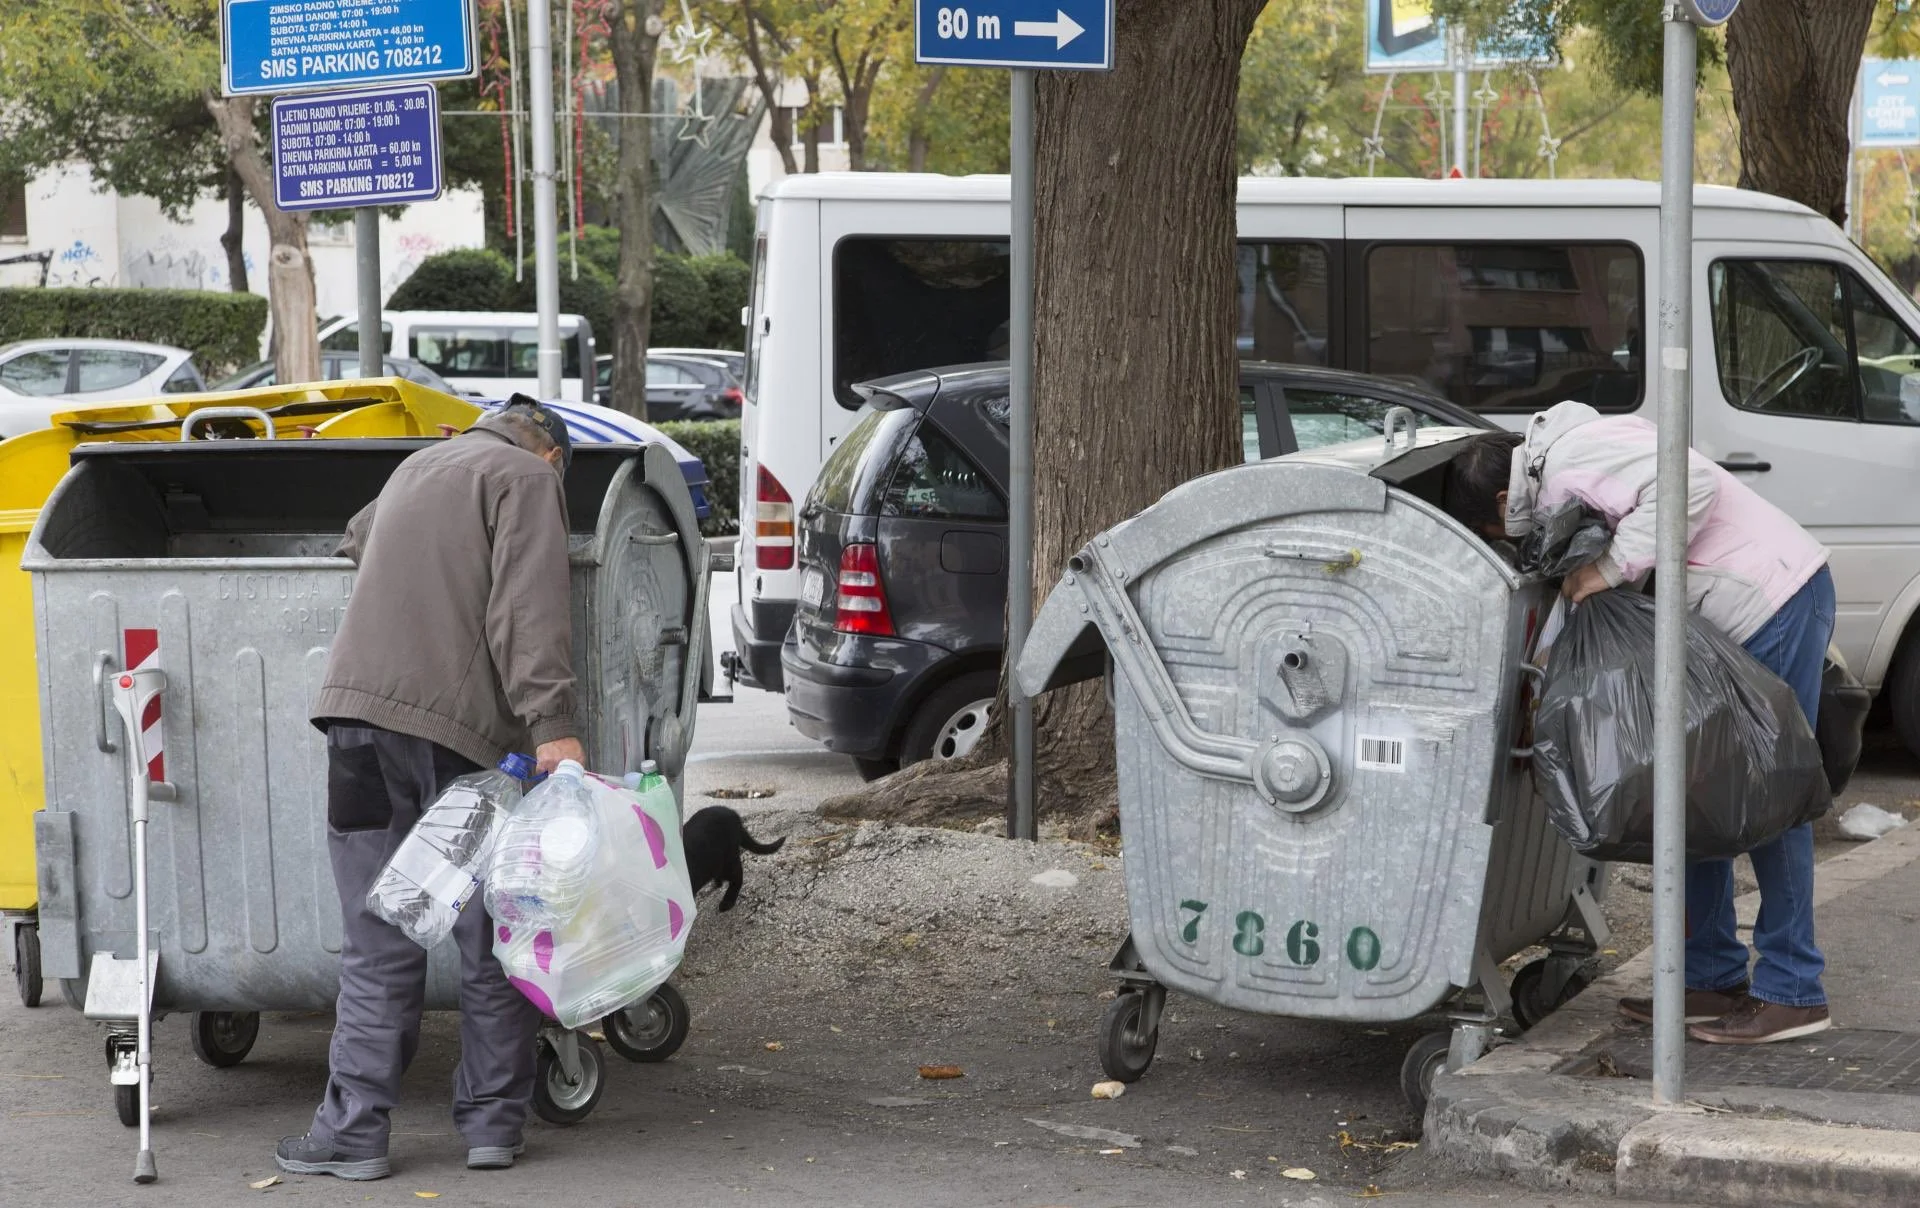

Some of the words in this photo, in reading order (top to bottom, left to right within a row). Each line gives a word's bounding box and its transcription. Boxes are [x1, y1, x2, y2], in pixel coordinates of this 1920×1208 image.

[270, 4, 302, 14] ZIMSKO
[304, 1, 334, 10] RADNO
[270, 14, 303, 25] RADNIM
[306, 11, 339, 21] DANOM:
[342, 9, 363, 18] 07:00
[371, 6, 392, 15] 19:00
[394, 5, 399, 13] h
[271, 25, 307, 35] SUBOTA:
[310, 22, 331, 32] 07:00
[339, 20, 360, 28] 14:00
[938, 8, 968, 39] 80
[977, 15, 1000, 39] m
[271, 35, 306, 46] DNEVNA
[308, 31, 351, 42] PARKIRNA
[353, 28, 382, 38] KARTA
[390, 25, 412, 35] 48,00
[414, 24, 424, 32] kn
[271, 46, 299, 56] SATNA
[301, 42, 344, 54] PARKIRNA
[346, 40, 375, 50] KARTA
[395, 36, 412, 46] 4,00
[414, 35, 424, 43] kn
[261, 58, 297, 78] SMS
[302, 50, 379, 76] PARKING
[384, 44, 442, 68] 708212
[280, 109, 308, 123] LJETNO
[310, 106, 336, 120] RADNO
[338, 102, 372, 117] VRIJEME:
[374, 100, 397, 113] 01.06.
[404, 97, 427, 110] 30.09.
[281, 122, 311, 136] RADNIM
[313, 120, 342, 133] DANOM:
[344, 117, 366, 130] 07:00
[373, 115, 393, 127] 19:00
[395, 114, 400, 125] h
[282, 136, 313, 150] SUBOTA:
[315, 134, 336, 147] 07:00
[343, 132, 363, 144] 14:00
[365, 131, 370, 142] h
[282, 150, 312, 164] DNEVNA
[315, 146, 352, 161] PARKIRNA
[354, 144, 378, 157] KARTA
[389, 141, 410, 154] 60,00
[412, 140, 421, 152] kn
[283, 164, 307, 177] SATNA
[309, 161, 346, 175] PARKIRNA
[348, 158, 372, 171] KARTA
[395, 155, 411, 168] 5,00
[413, 155, 422, 165] kn
[300, 180, 323, 197] SMS
[327, 176, 372, 195] PARKING
[375, 172, 414, 190] 708212
[1180, 898, 1381, 972] 7860
